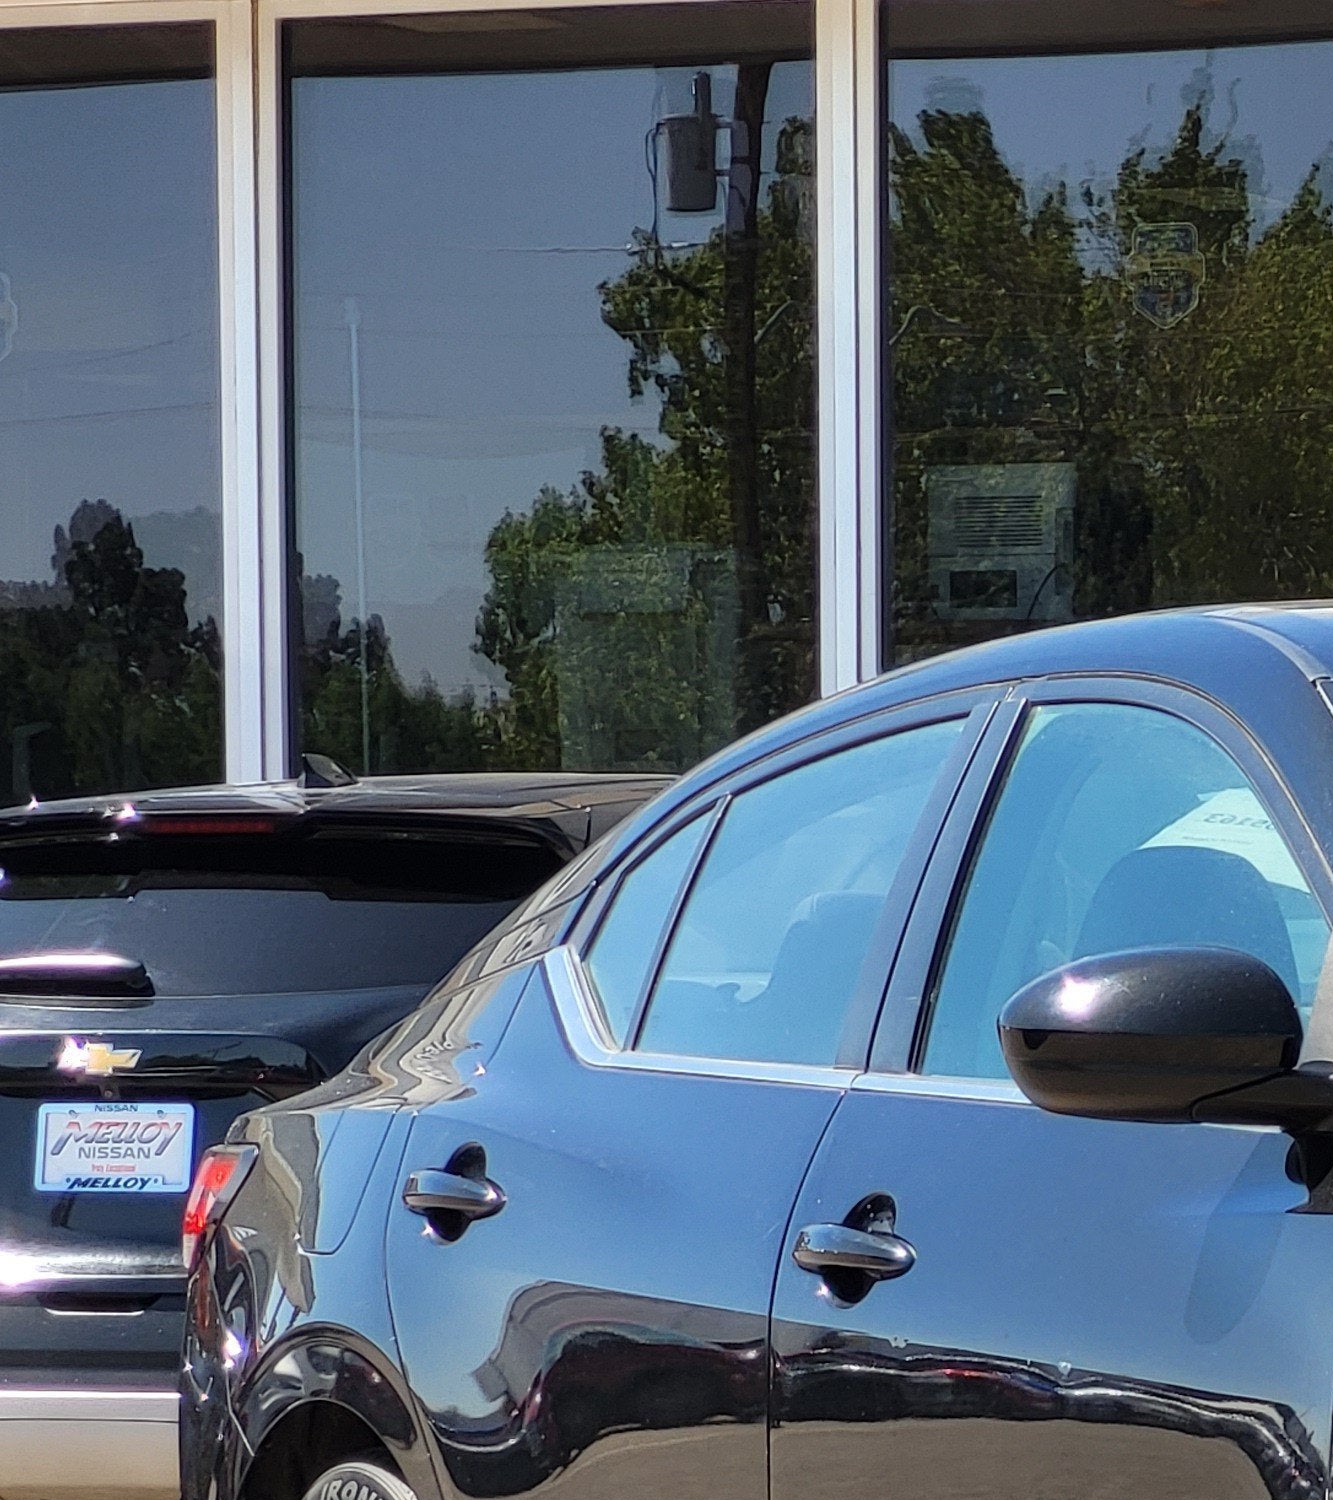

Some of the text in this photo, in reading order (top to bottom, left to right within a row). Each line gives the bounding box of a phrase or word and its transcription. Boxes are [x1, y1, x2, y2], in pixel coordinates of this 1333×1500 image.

[94, 1104, 139, 1112] NISSAN
[50, 1121, 183, 1156] MELLOY
[78, 1146, 151, 1159] NISSAN
[67, 1177, 152, 1190] MELLOY
